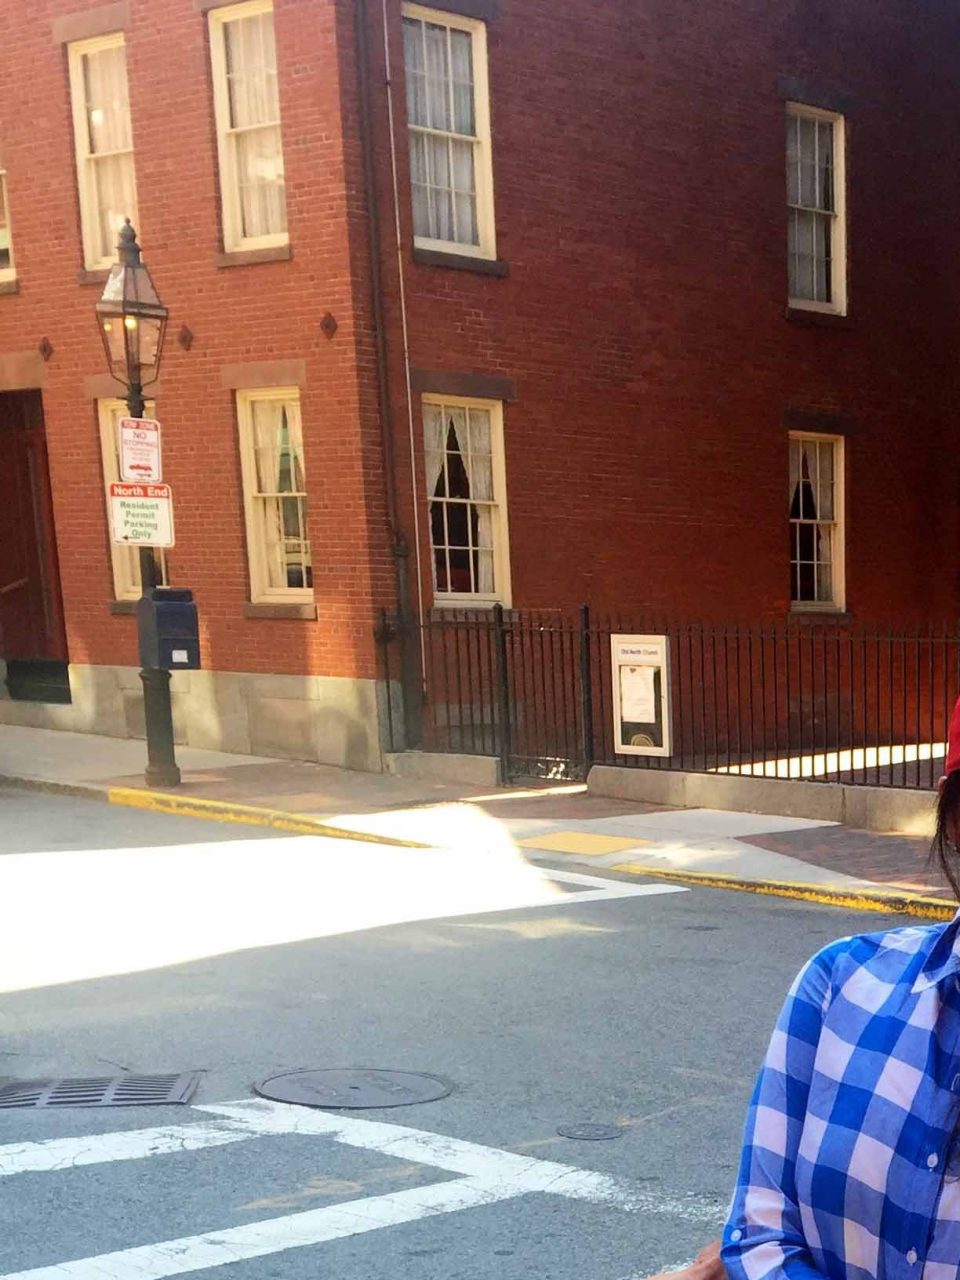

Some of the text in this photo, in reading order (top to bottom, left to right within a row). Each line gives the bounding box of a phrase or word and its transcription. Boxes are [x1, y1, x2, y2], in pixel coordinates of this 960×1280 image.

[133, 431, 147, 440] NO
[113, 486, 168, 496] North End
[120, 501, 159, 510] Resident
[125, 510, 155, 519] Permit
[123, 520, 158, 531] Parking
[131, 529, 152, 539] Only
